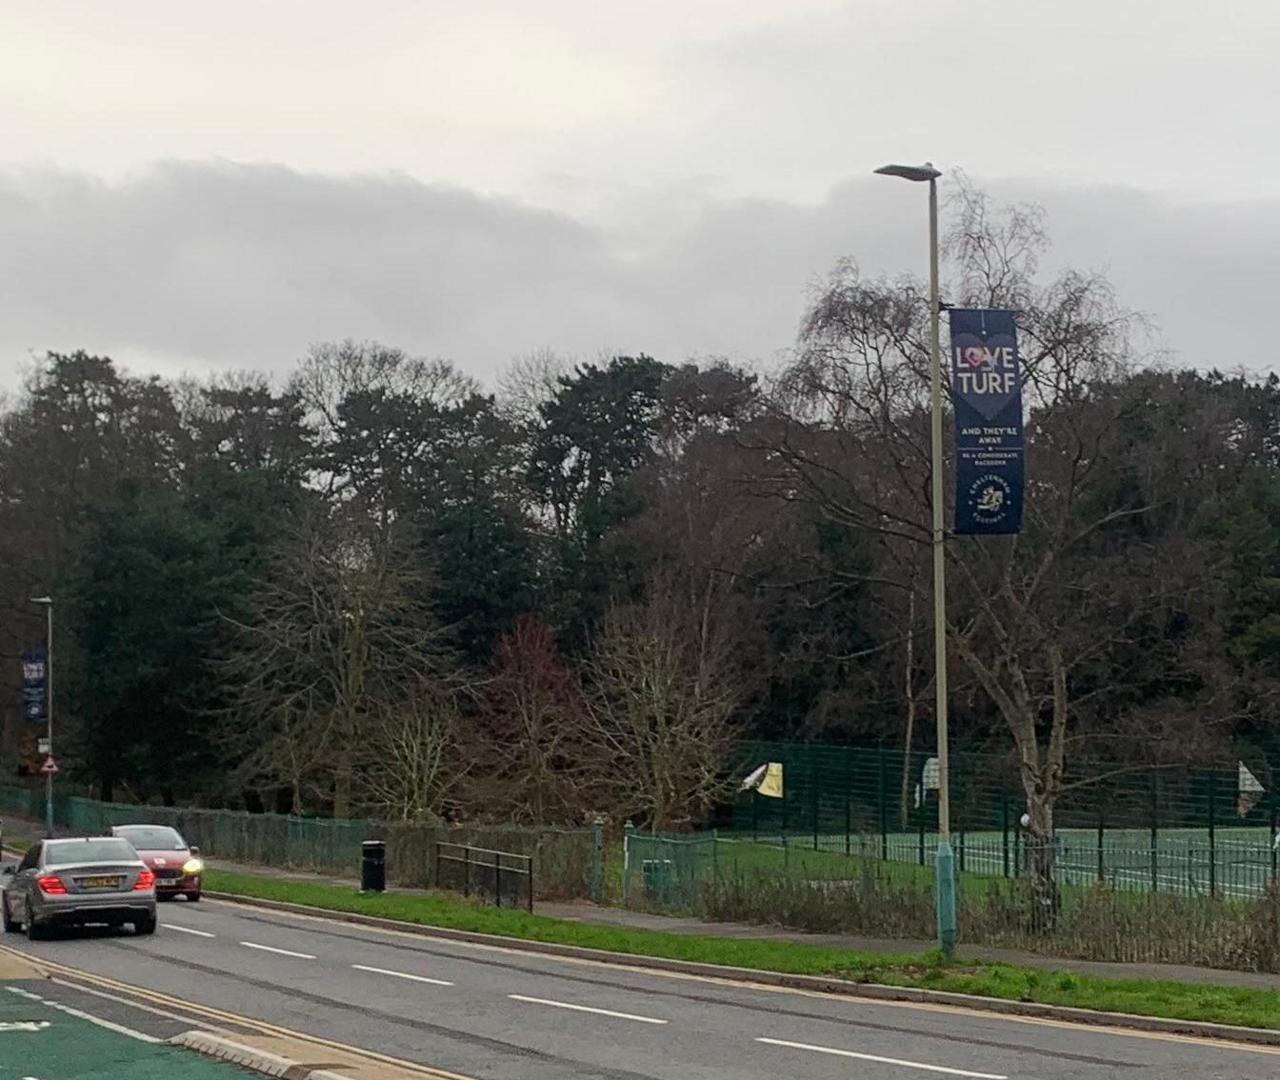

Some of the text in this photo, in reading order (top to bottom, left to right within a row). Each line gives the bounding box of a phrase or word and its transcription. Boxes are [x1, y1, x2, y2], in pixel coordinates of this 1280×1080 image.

[955, 346, 1015, 368] LOVE
[957, 372, 1016, 394] TURF
[961, 427, 982, 435] AND
[978, 436, 1002, 444] AWAY
